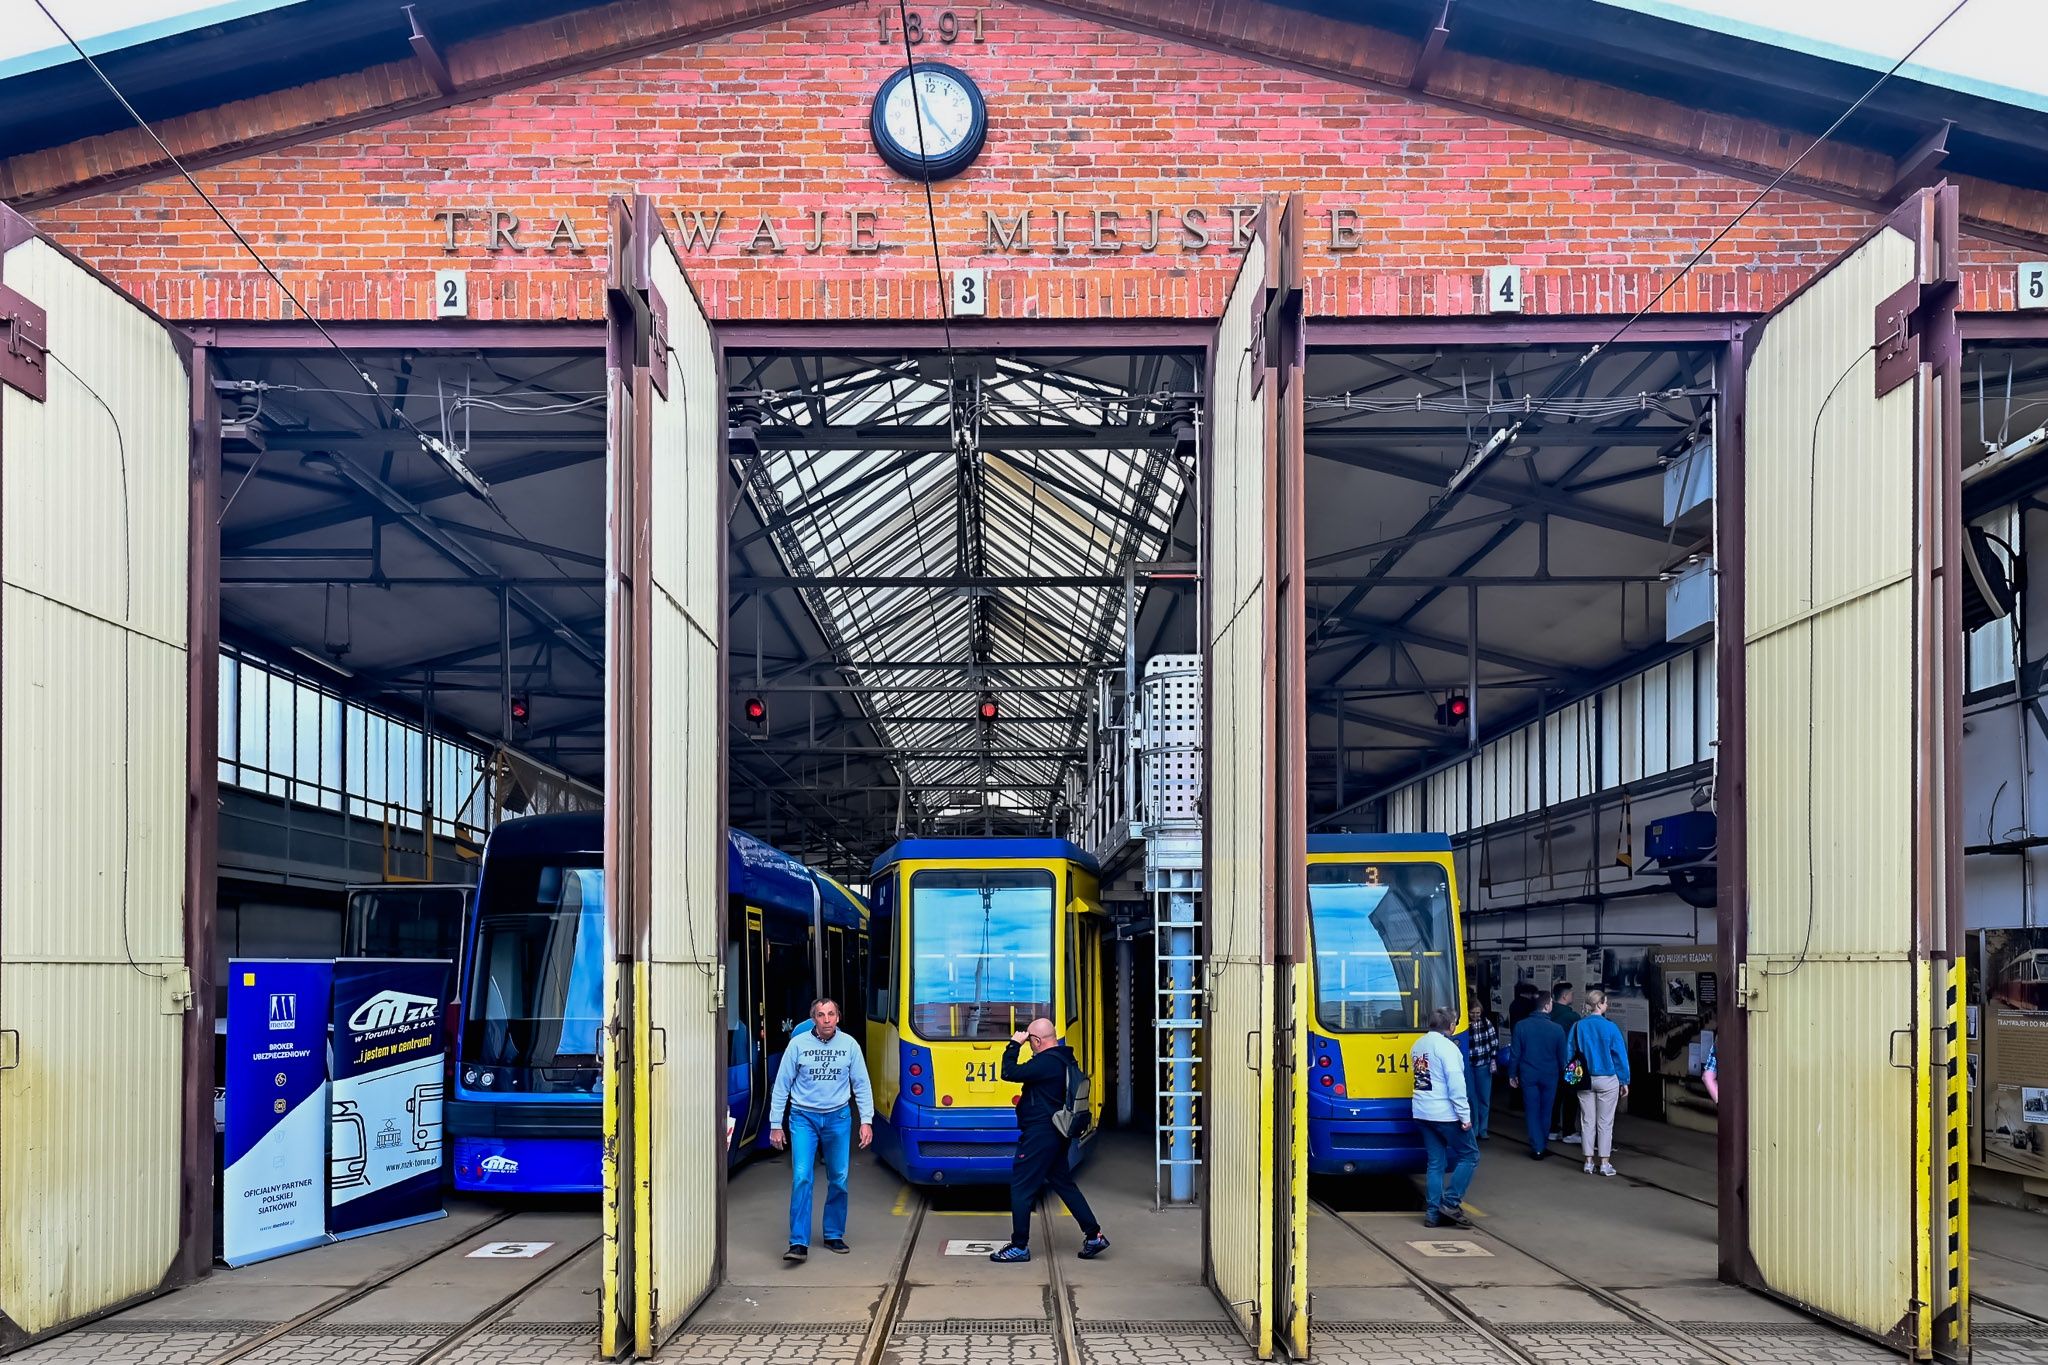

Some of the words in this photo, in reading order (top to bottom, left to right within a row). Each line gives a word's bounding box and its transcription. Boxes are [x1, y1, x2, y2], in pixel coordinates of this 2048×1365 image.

[879, 9, 985, 44] 1891
[434, 208, 881, 253] TRAWAJE
[983, 207, 1363, 251] MIEJSKE
[443, 279, 458, 307] 2
[961, 276, 976, 305] 3
[1499, 275, 1514, 303] 4
[2028, 271, 2044, 298] 5
[1365, 866, 1378, 886] 3
[354, 1035, 364, 1043] w
[364, 1028, 397, 1041] Toruniu
[397, 1023, 411, 1033] Sp.
[420, 1020, 436, 1028] o.o.
[252, 1050, 311, 1061] UBEZPIECZENIOWY
[269, 1042, 294, 1051] BROKER
[363, 1046, 390, 1064] jestem
[390, 1044, 398, 1055] w
[398, 1034, 432, 1052] centrum!
[965, 1061, 998, 1082] 241
[1376, 1053, 1409, 1074] 214
[243, 1184, 281, 1198] OFICJALNY
[281, 1178, 313, 1190] PARTNER
[262, 1191, 294, 1204] POLSKIEJ
[491, 1244, 528, 1255] 5
[965, 1243, 995, 1253] 5
[1431, 1243, 1466, 1254] 5
